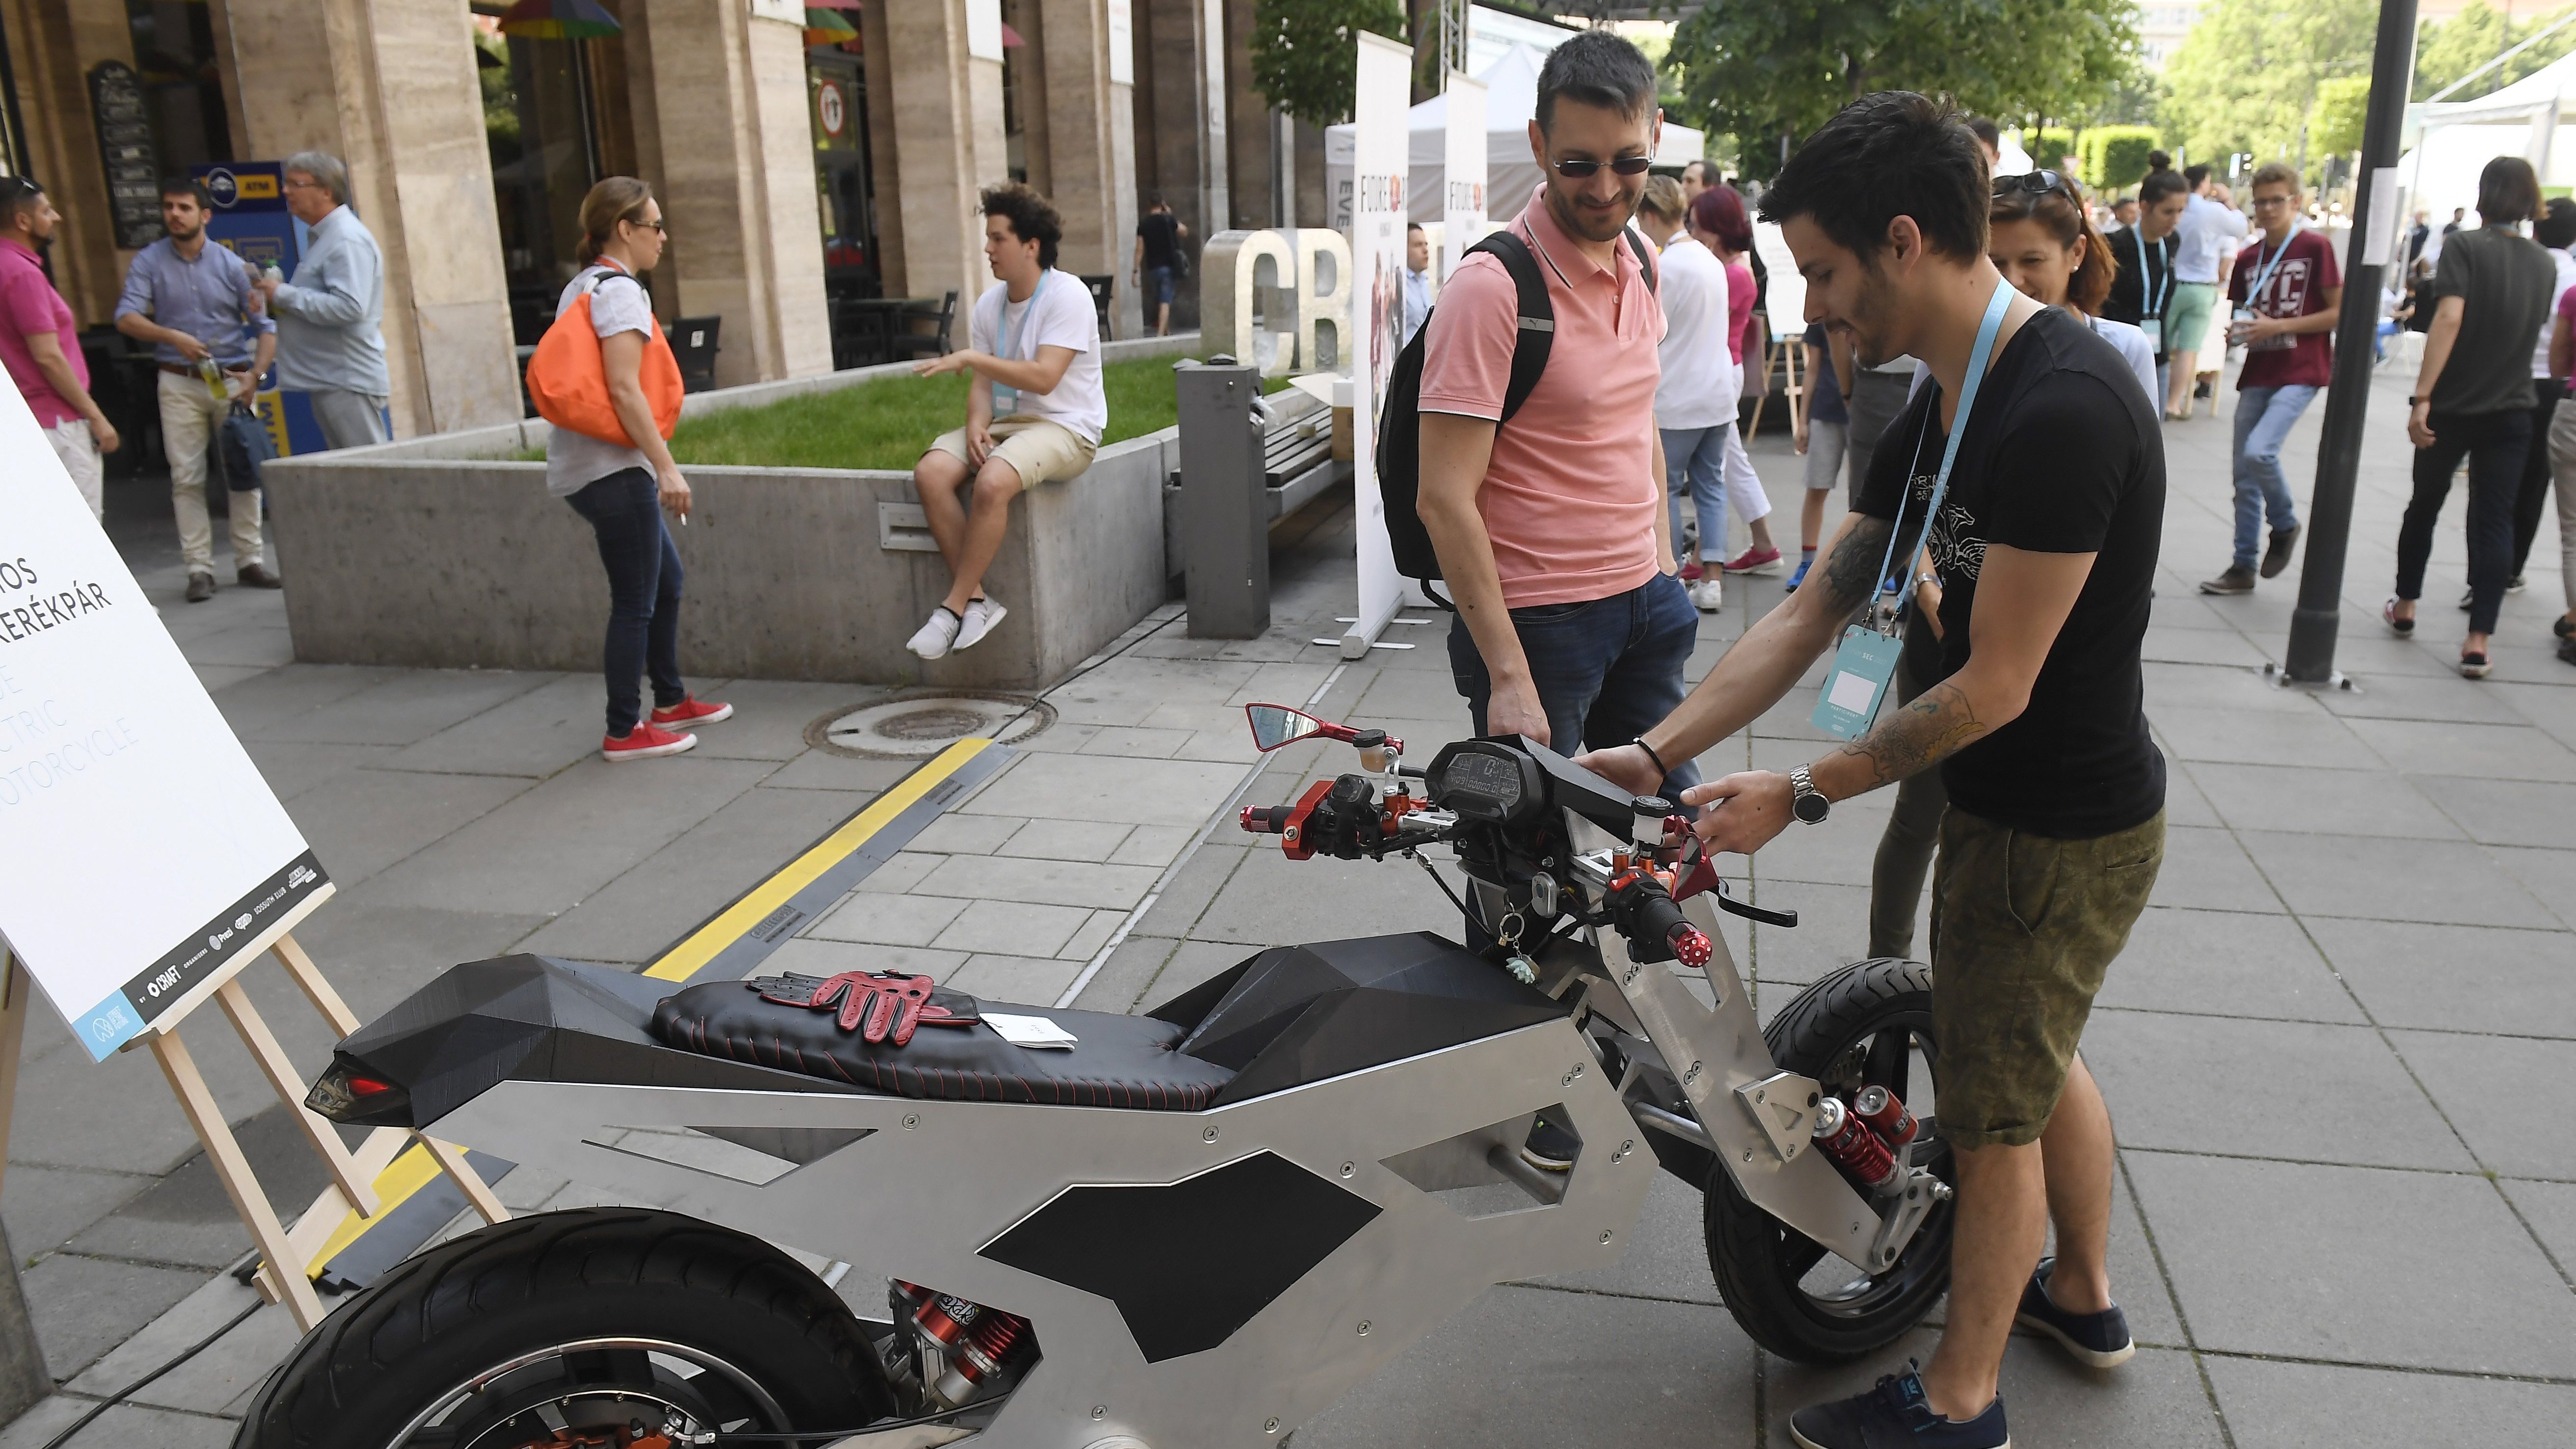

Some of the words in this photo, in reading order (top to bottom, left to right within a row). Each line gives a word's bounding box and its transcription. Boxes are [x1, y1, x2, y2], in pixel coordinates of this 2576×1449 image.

[1336, 180, 1353, 233] EVE
[0, 558, 37, 593] OS
[0, 665, 23, 700] E
[156, 964, 182, 991] CRAFT
[183, 948, 208, 969] ORGANISERS
[217, 927, 234, 943] Prezi
